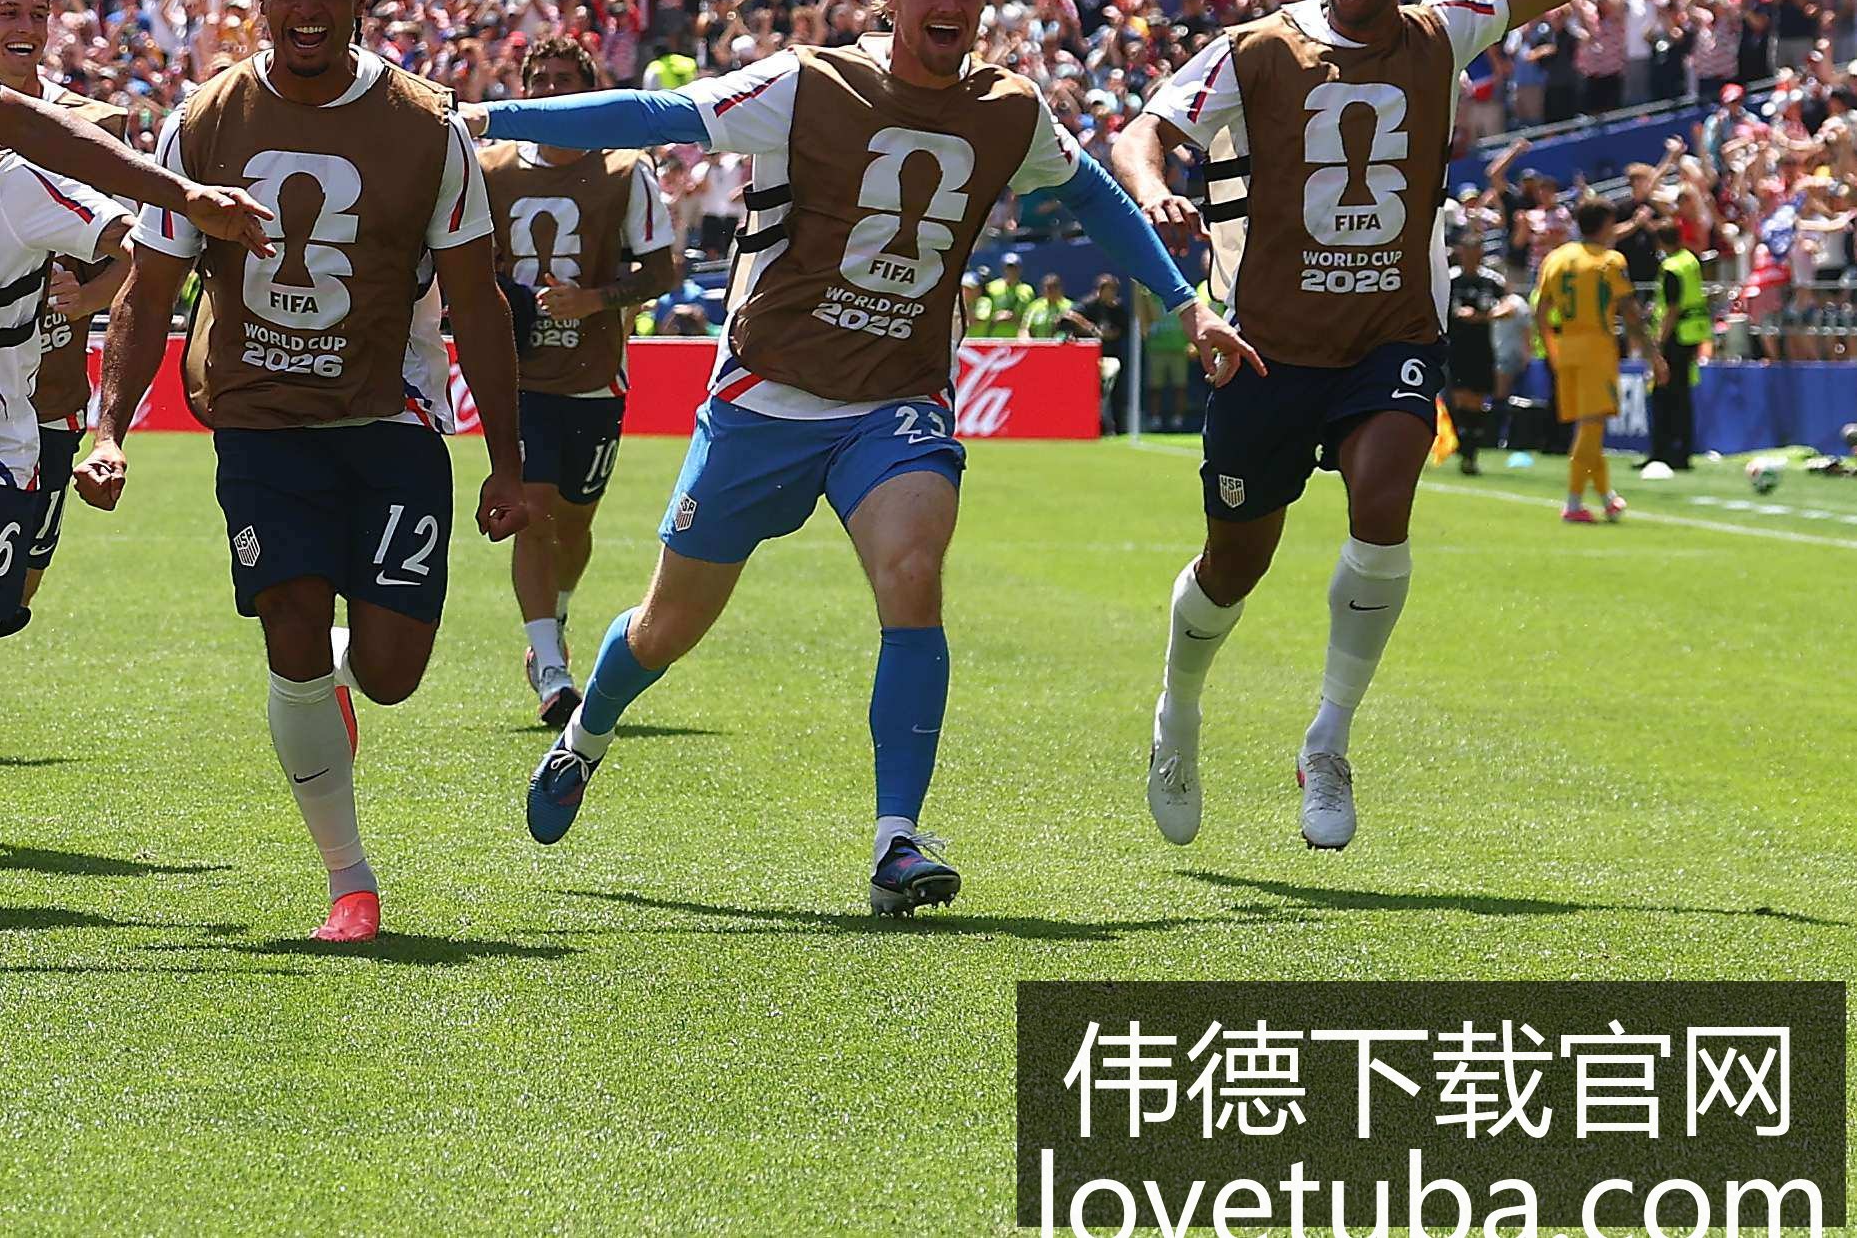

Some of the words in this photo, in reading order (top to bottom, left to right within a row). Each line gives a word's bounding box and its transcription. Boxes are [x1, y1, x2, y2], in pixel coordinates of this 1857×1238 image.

[1335, 214, 1382, 232] FIFA
[869, 260, 915, 284] FIFA
[1302, 250, 1368, 266] WORLD
[1371, 250, 1402, 265] CUP
[1300, 267, 1402, 293] 2026
[270, 291, 319, 313] FIFA
[825, 286, 891, 312] WORLD
[1558, 272, 1578, 322] 5
[812, 302, 913, 340] 2026
[39, 324, 72, 353] 26
[244, 322, 305, 352] WORLD
[308, 335, 347, 353] CUP
[530, 330, 580, 348] 026
[242, 341, 344, 378] 2026
[1399, 358, 1427, 387] 6
[585, 439, 619, 483] 10
[373, 503, 440, 577] 12
